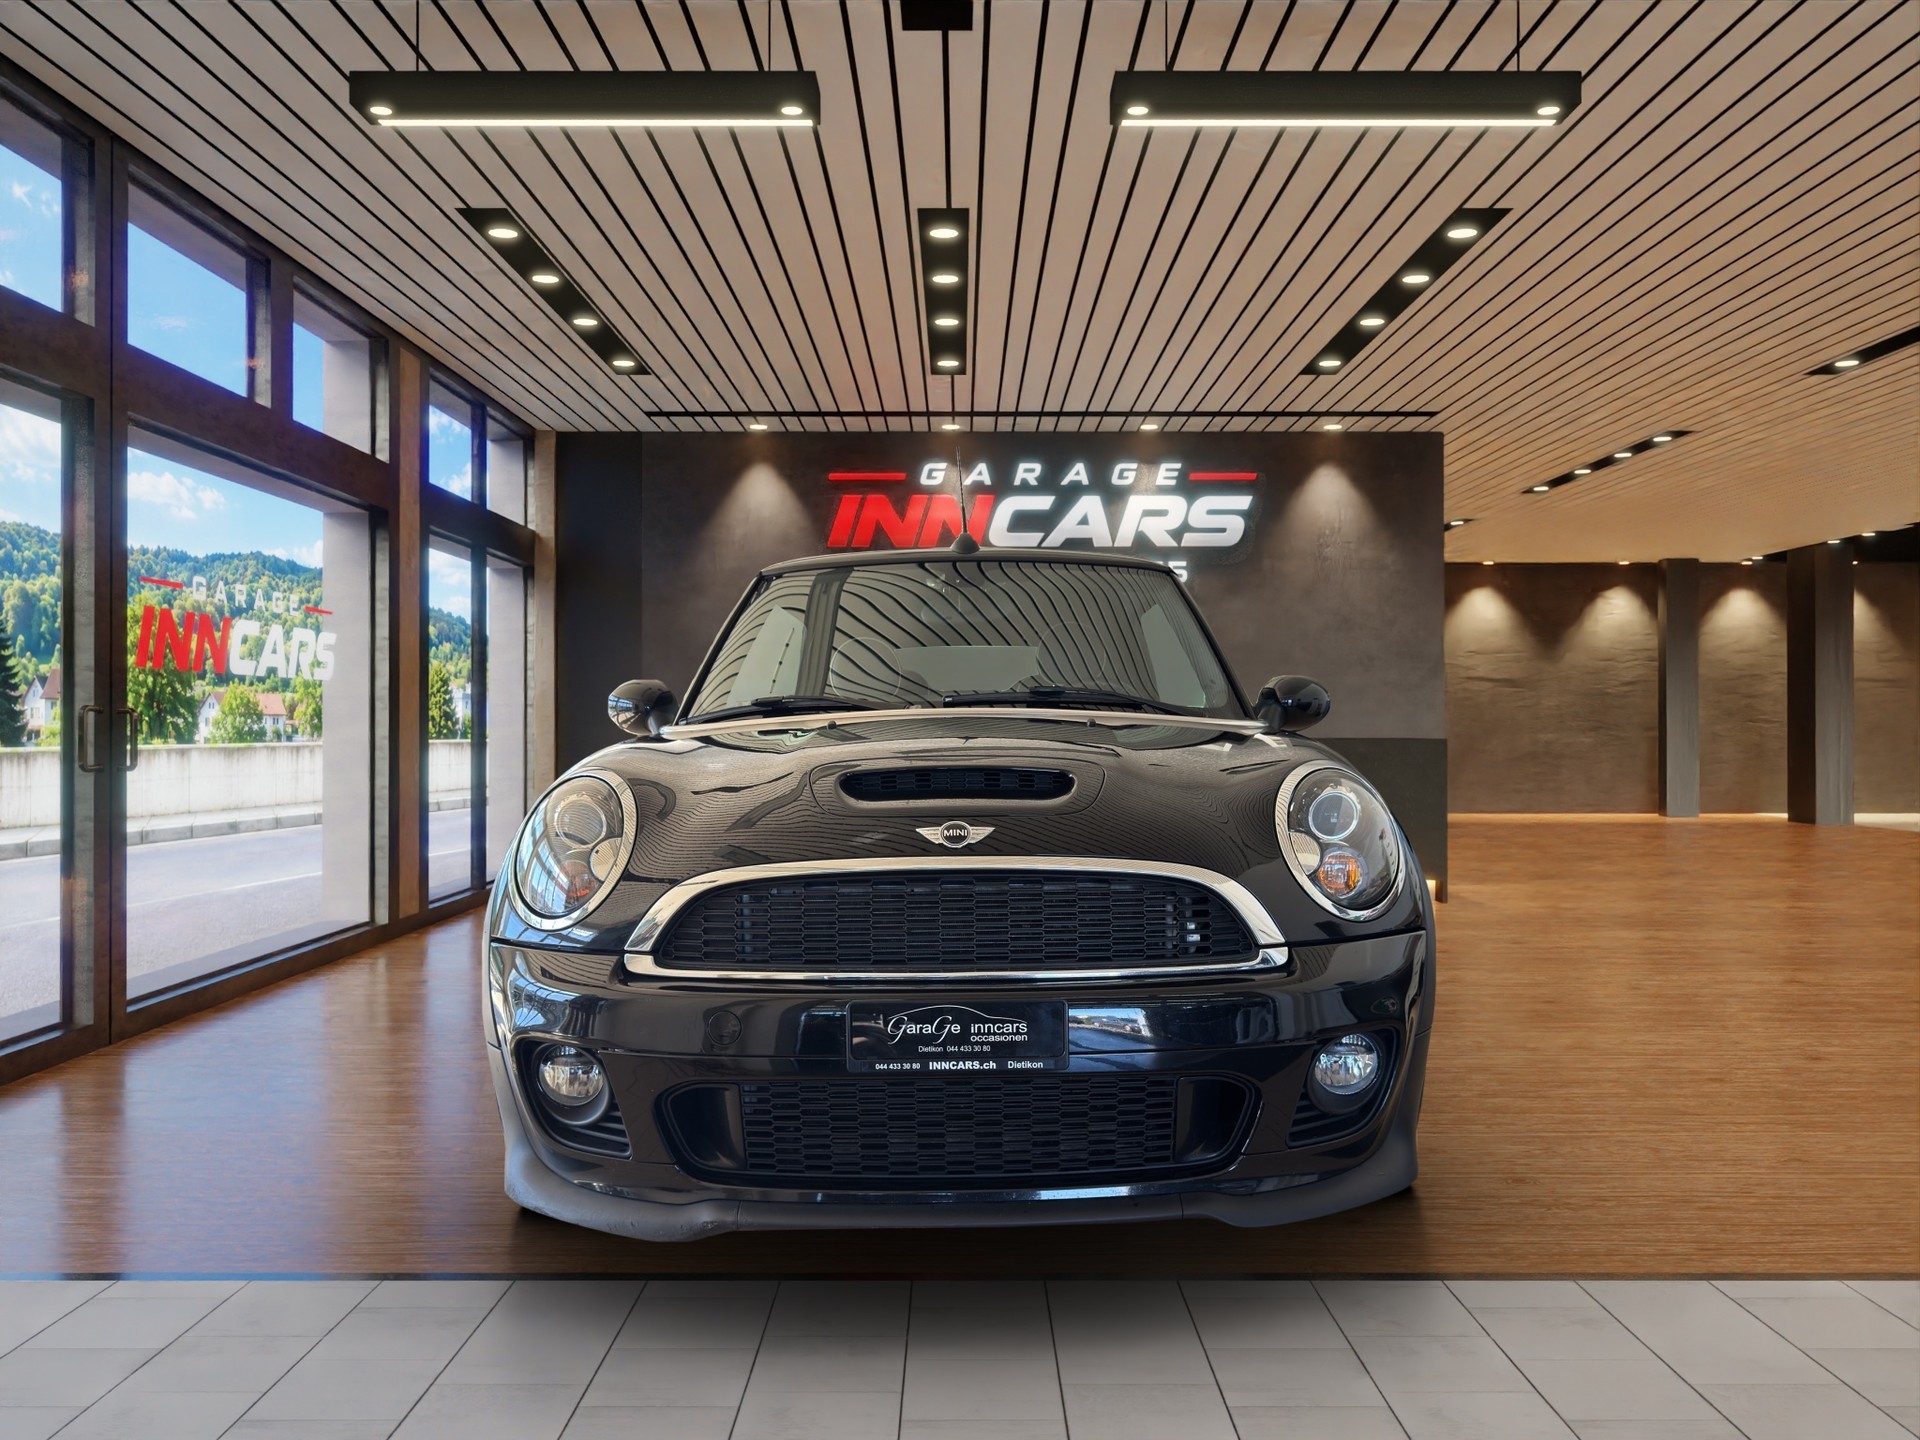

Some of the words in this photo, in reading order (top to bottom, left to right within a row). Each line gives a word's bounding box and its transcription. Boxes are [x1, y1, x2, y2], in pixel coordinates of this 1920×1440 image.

[919, 462, 1182, 486] GARAGE
[827, 494, 1253, 548] INNCARS
[192, 575, 300, 617] GARAGE
[135, 605, 337, 681] INNCARS
[970, 1022, 1028, 1034] inncars
[970, 1034, 1028, 1042] occasionen
[918, 1045, 943, 1053] Dietikon
[960, 1045, 972, 1053] 433
[912, 1062, 921, 1070] 80
[929, 1061, 996, 1070] INNCARS.ch
[1007, 1060, 1043, 1069] Dietikon
